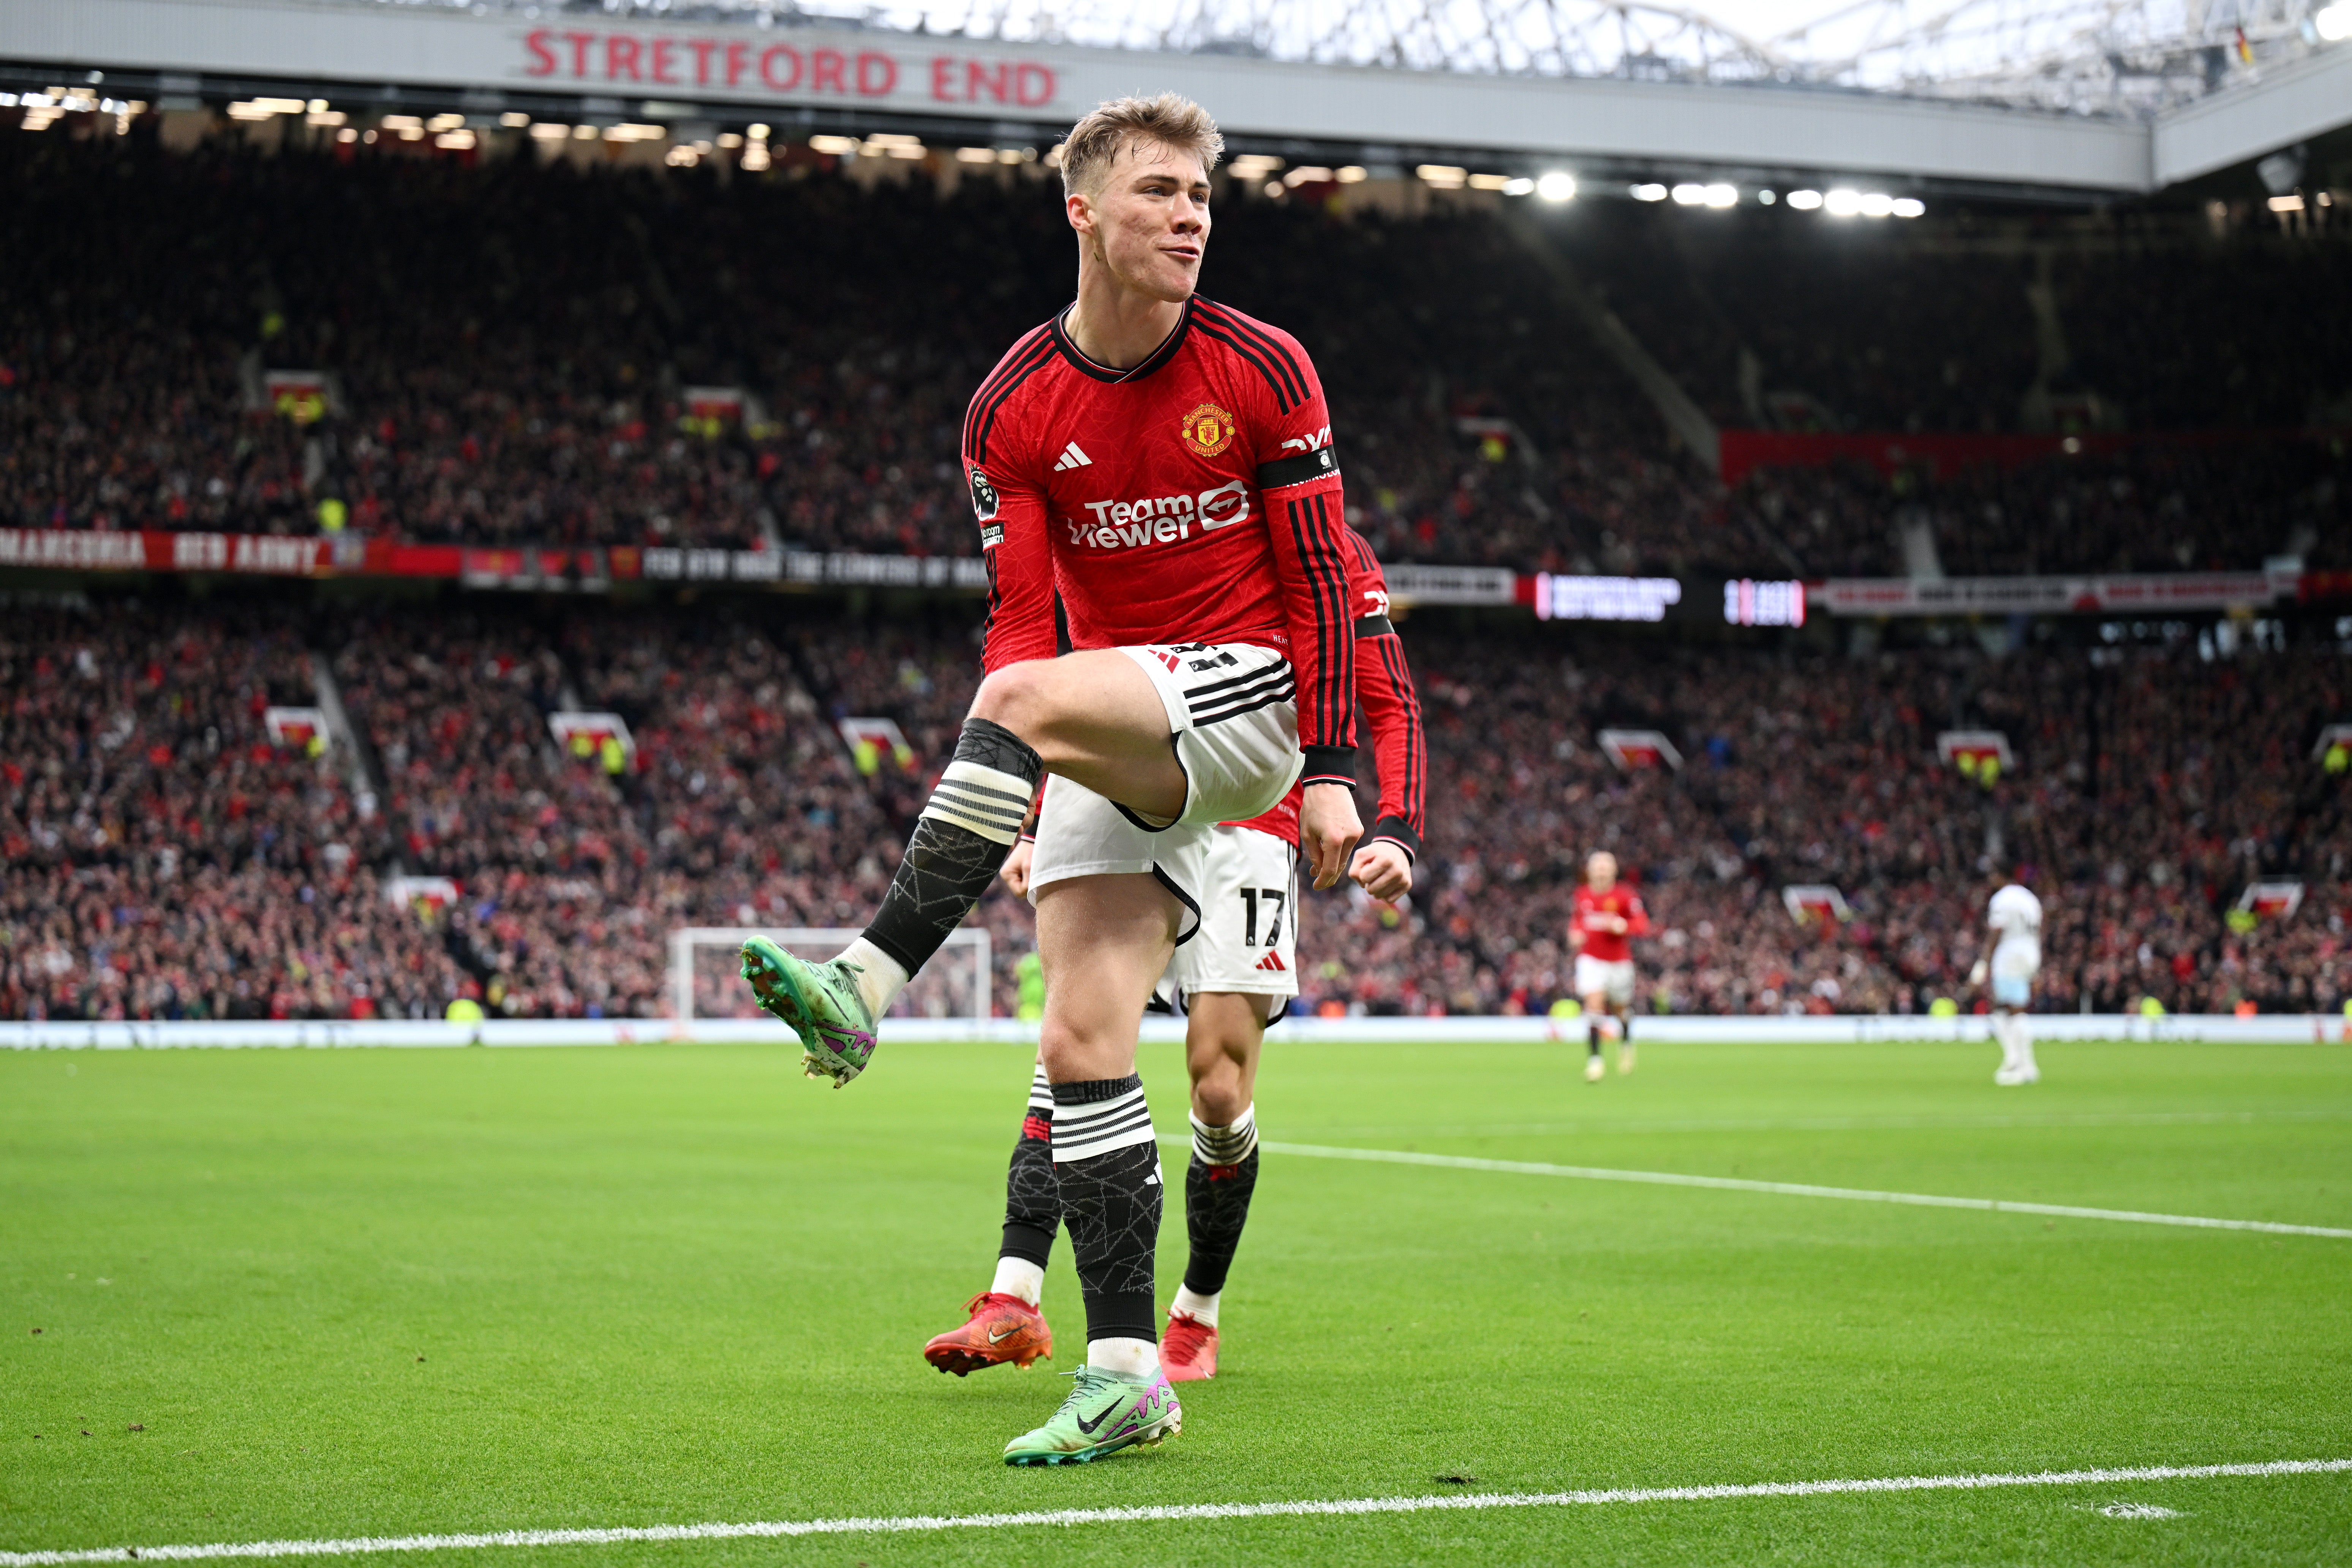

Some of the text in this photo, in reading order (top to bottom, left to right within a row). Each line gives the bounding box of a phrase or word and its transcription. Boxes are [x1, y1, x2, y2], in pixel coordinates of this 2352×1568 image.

[524, 29, 1057, 107] STRETFORD END
[1186, 407, 1229, 425] MANCHESTER
[1195, 443, 1225, 453] UNITED
[1084, 495, 1194, 526] Team
[986, 525, 1000, 537] room
[1067, 513, 1195, 548] Viewer
[1273, 634, 1288, 645] HEAT
[1240, 888, 1285, 946] 17
